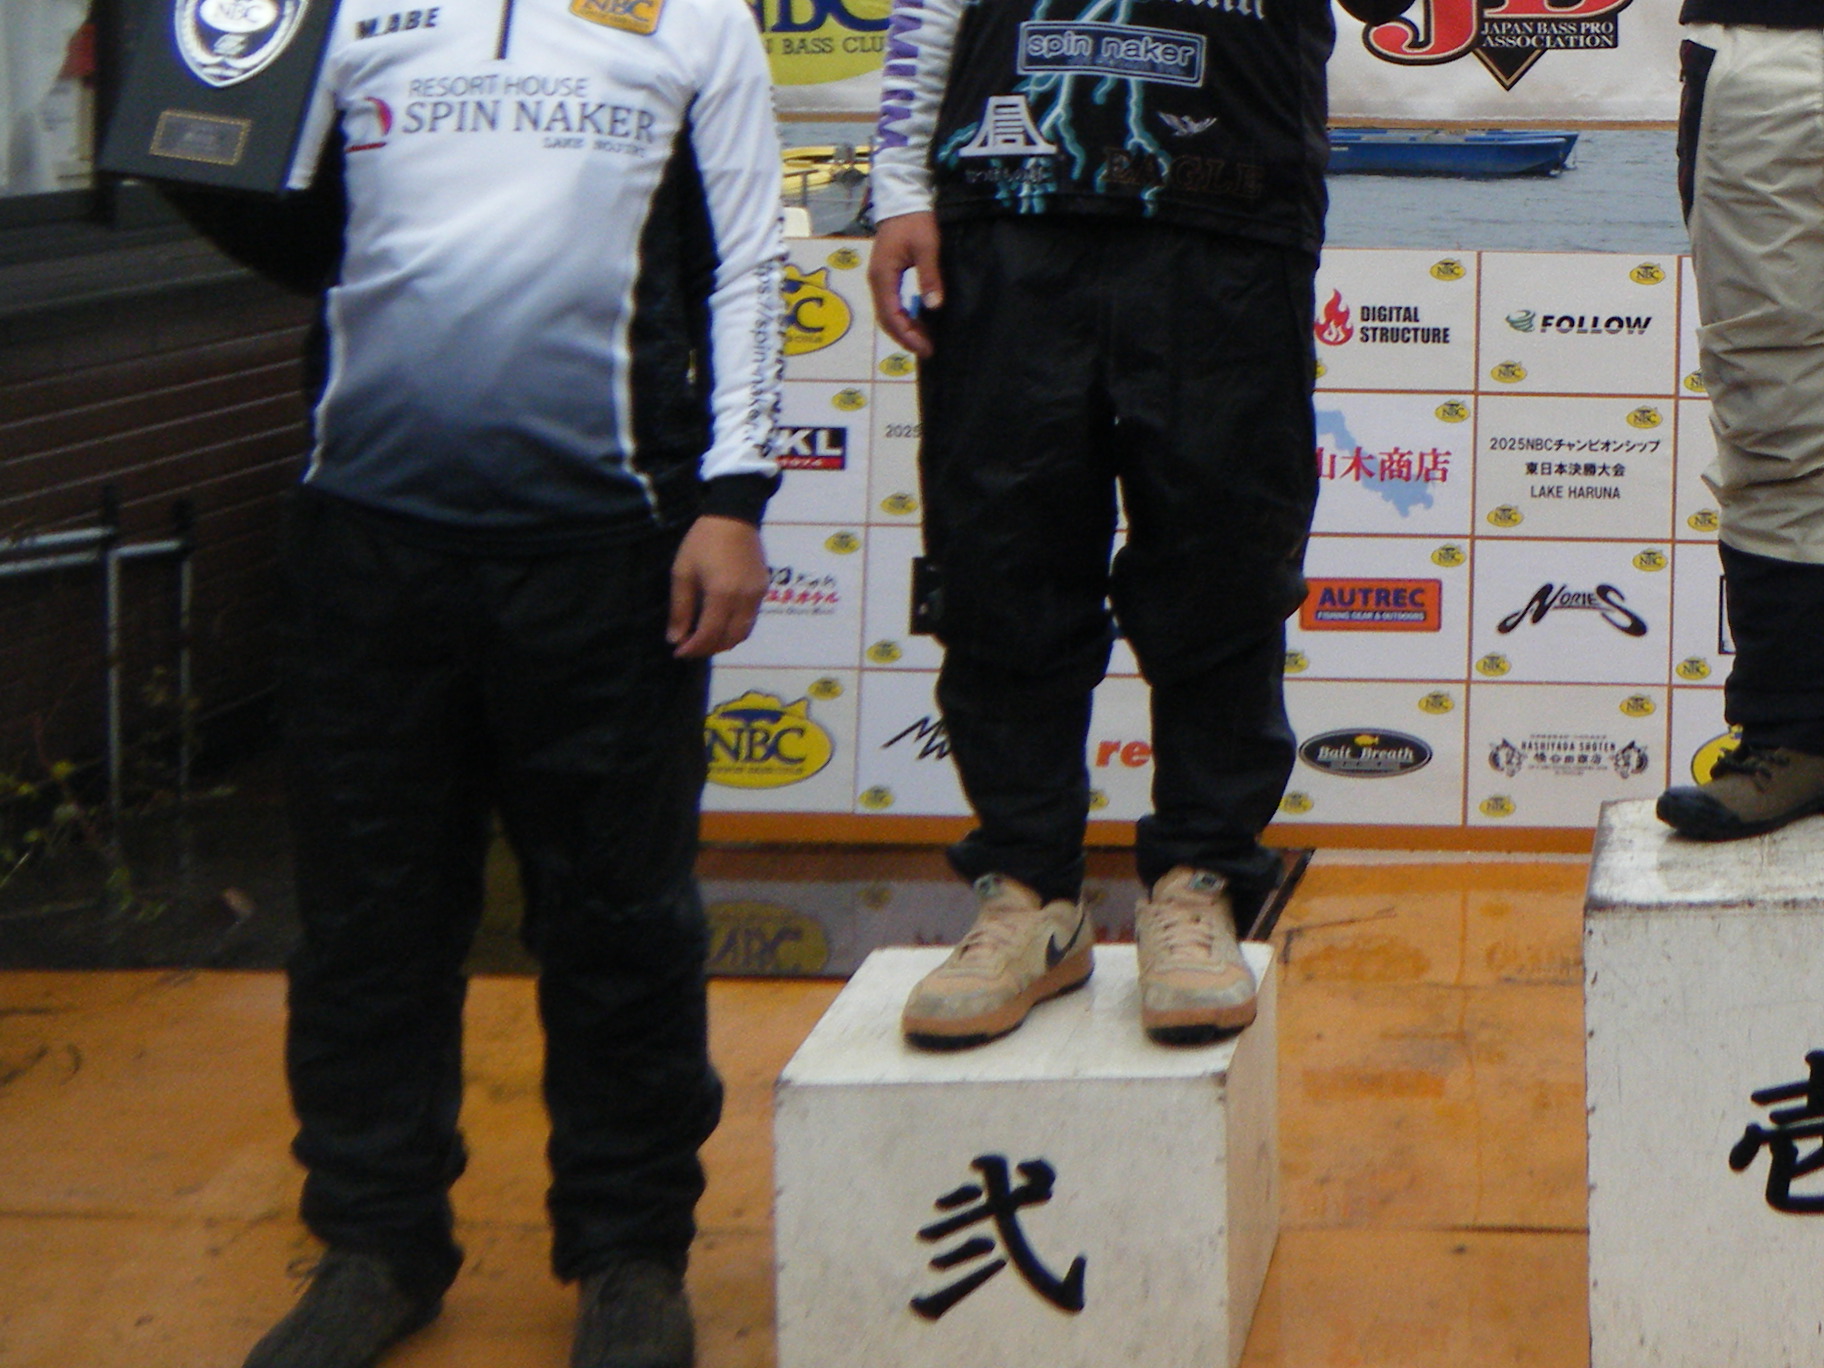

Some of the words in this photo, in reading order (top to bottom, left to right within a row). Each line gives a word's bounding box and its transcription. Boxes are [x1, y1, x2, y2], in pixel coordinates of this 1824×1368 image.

[1481, 23, 1534, 37] JAPAN
[1537, 23, 1574, 36] BASS
[1580, 23, 1614, 36] PRO
[782, 35, 833, 53] BASS
[842, 33, 886, 53] CLU
[1028, 31, 1093, 58] spin
[1101, 36, 1196, 67] naker
[1482, 36, 1614, 49] ASSOCIATION
[409, 75, 499, 98] RESORT
[504, 77, 589, 98] HOUSE
[402, 100, 500, 134] SPIN
[515, 101, 657, 144] NAKER
[1360, 306, 1420, 323] DIGITAL
[1540, 315, 1653, 335] FOLLOW
[1360, 327, 1450, 344] STRUCTURE
[781, 428, 843, 456] KL
[1489, 437, 1662, 454] 2025NBCチャンピオンシップ
[1525, 461, 1627, 477] 東日本決勝大会
[1530, 485, 1564, 499] LAKE
[1568, 485, 1621, 500] HARUNA
[1318, 587, 1426, 608] AUTREC
[704, 727, 805, 764] NBC
[1318, 746, 1351, 761] Bait
[1359, 748, 1414, 762] Breath
[910, 1153, 1087, 1320] 弐
